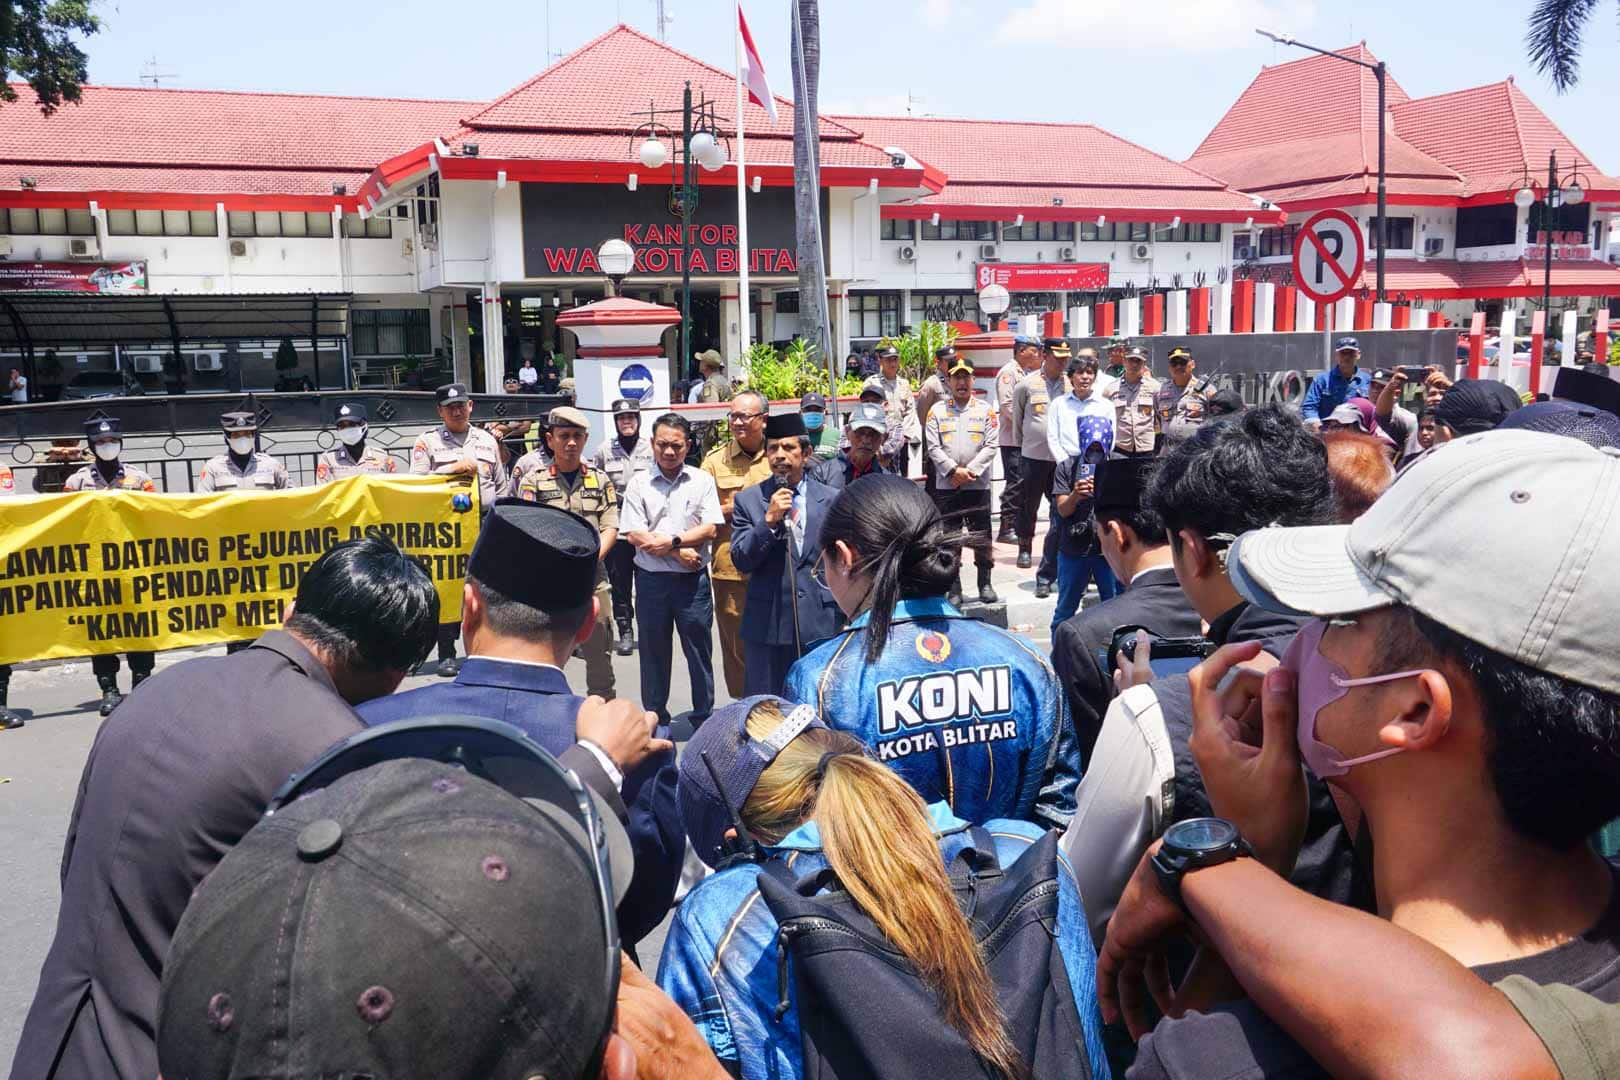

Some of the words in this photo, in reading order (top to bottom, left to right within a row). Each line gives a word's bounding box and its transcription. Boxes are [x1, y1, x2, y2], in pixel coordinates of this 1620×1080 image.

[624, 224, 738, 245] KANTOR
[544, 248, 708, 272] WAKOTA
[1315, 230, 1343, 283] P
[101, 537, 209, 571] DATANG
[219, 526, 338, 561] PEJUANG
[133, 563, 270, 604] PENDAPAT
[167, 604, 227, 633] SIAP
[877, 665, 1012, 736] KONI
[878, 732, 939, 761] KOTA
[943, 720, 1017, 748] BLITAR
